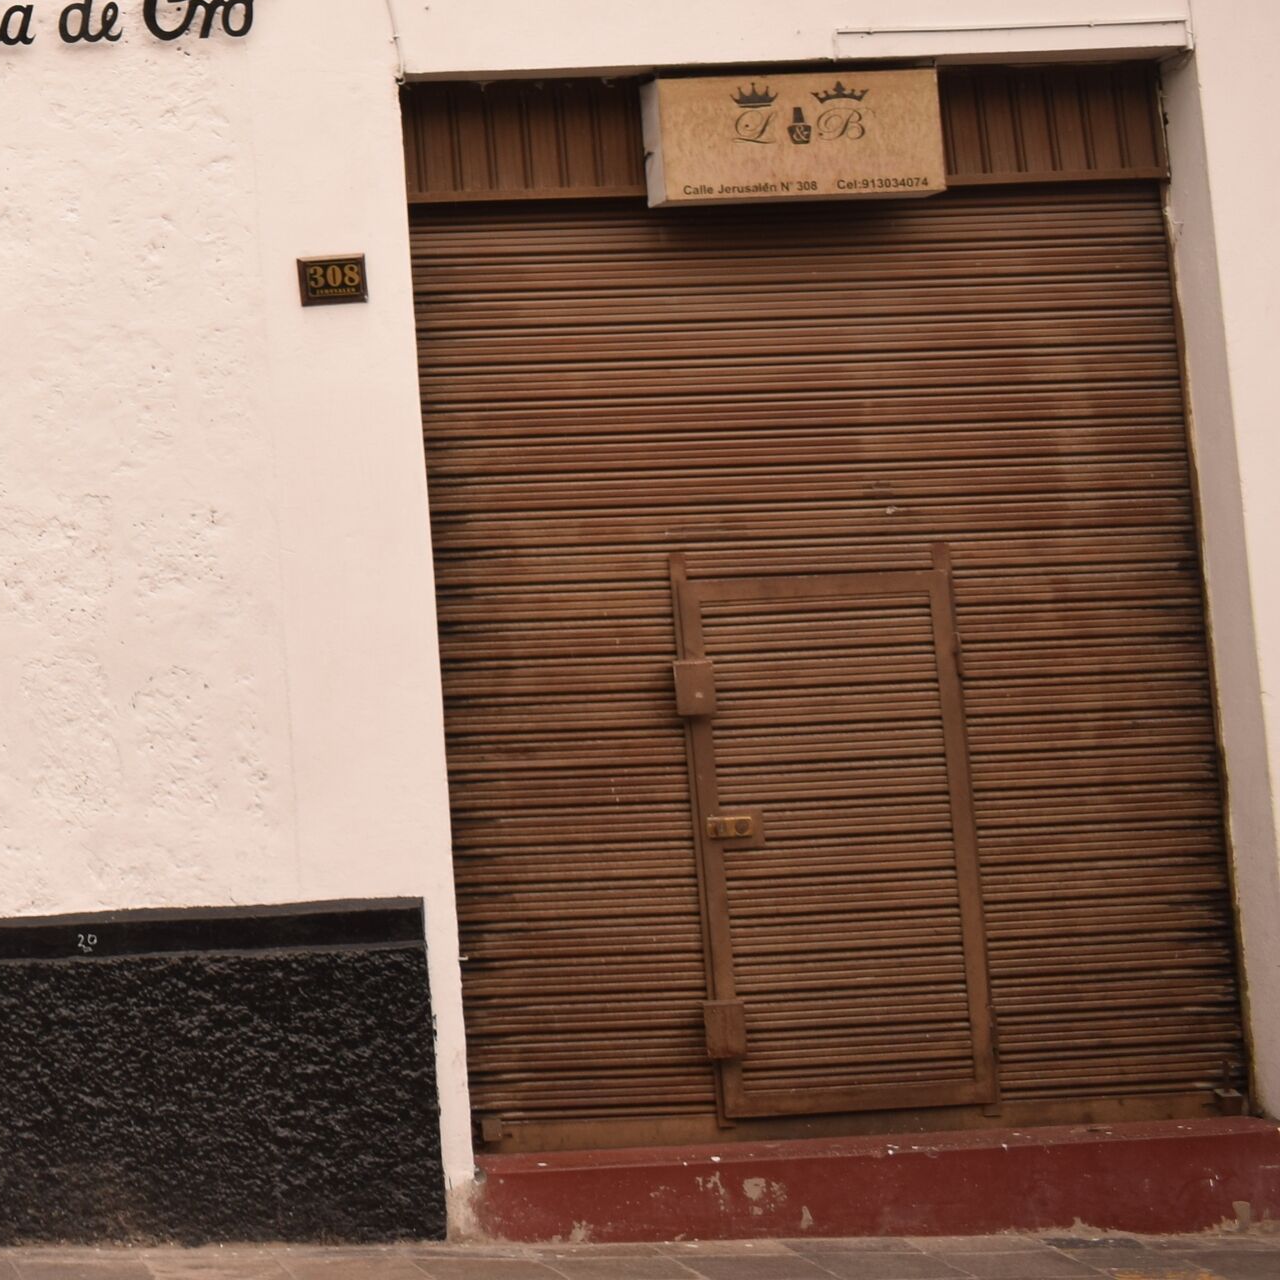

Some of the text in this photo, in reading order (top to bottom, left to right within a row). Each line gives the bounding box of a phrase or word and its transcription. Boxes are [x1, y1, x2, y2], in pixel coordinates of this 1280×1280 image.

[683, 184, 714, 196] Calle
[797, 181, 818, 192] 308
[309, 264, 361, 288] 308
